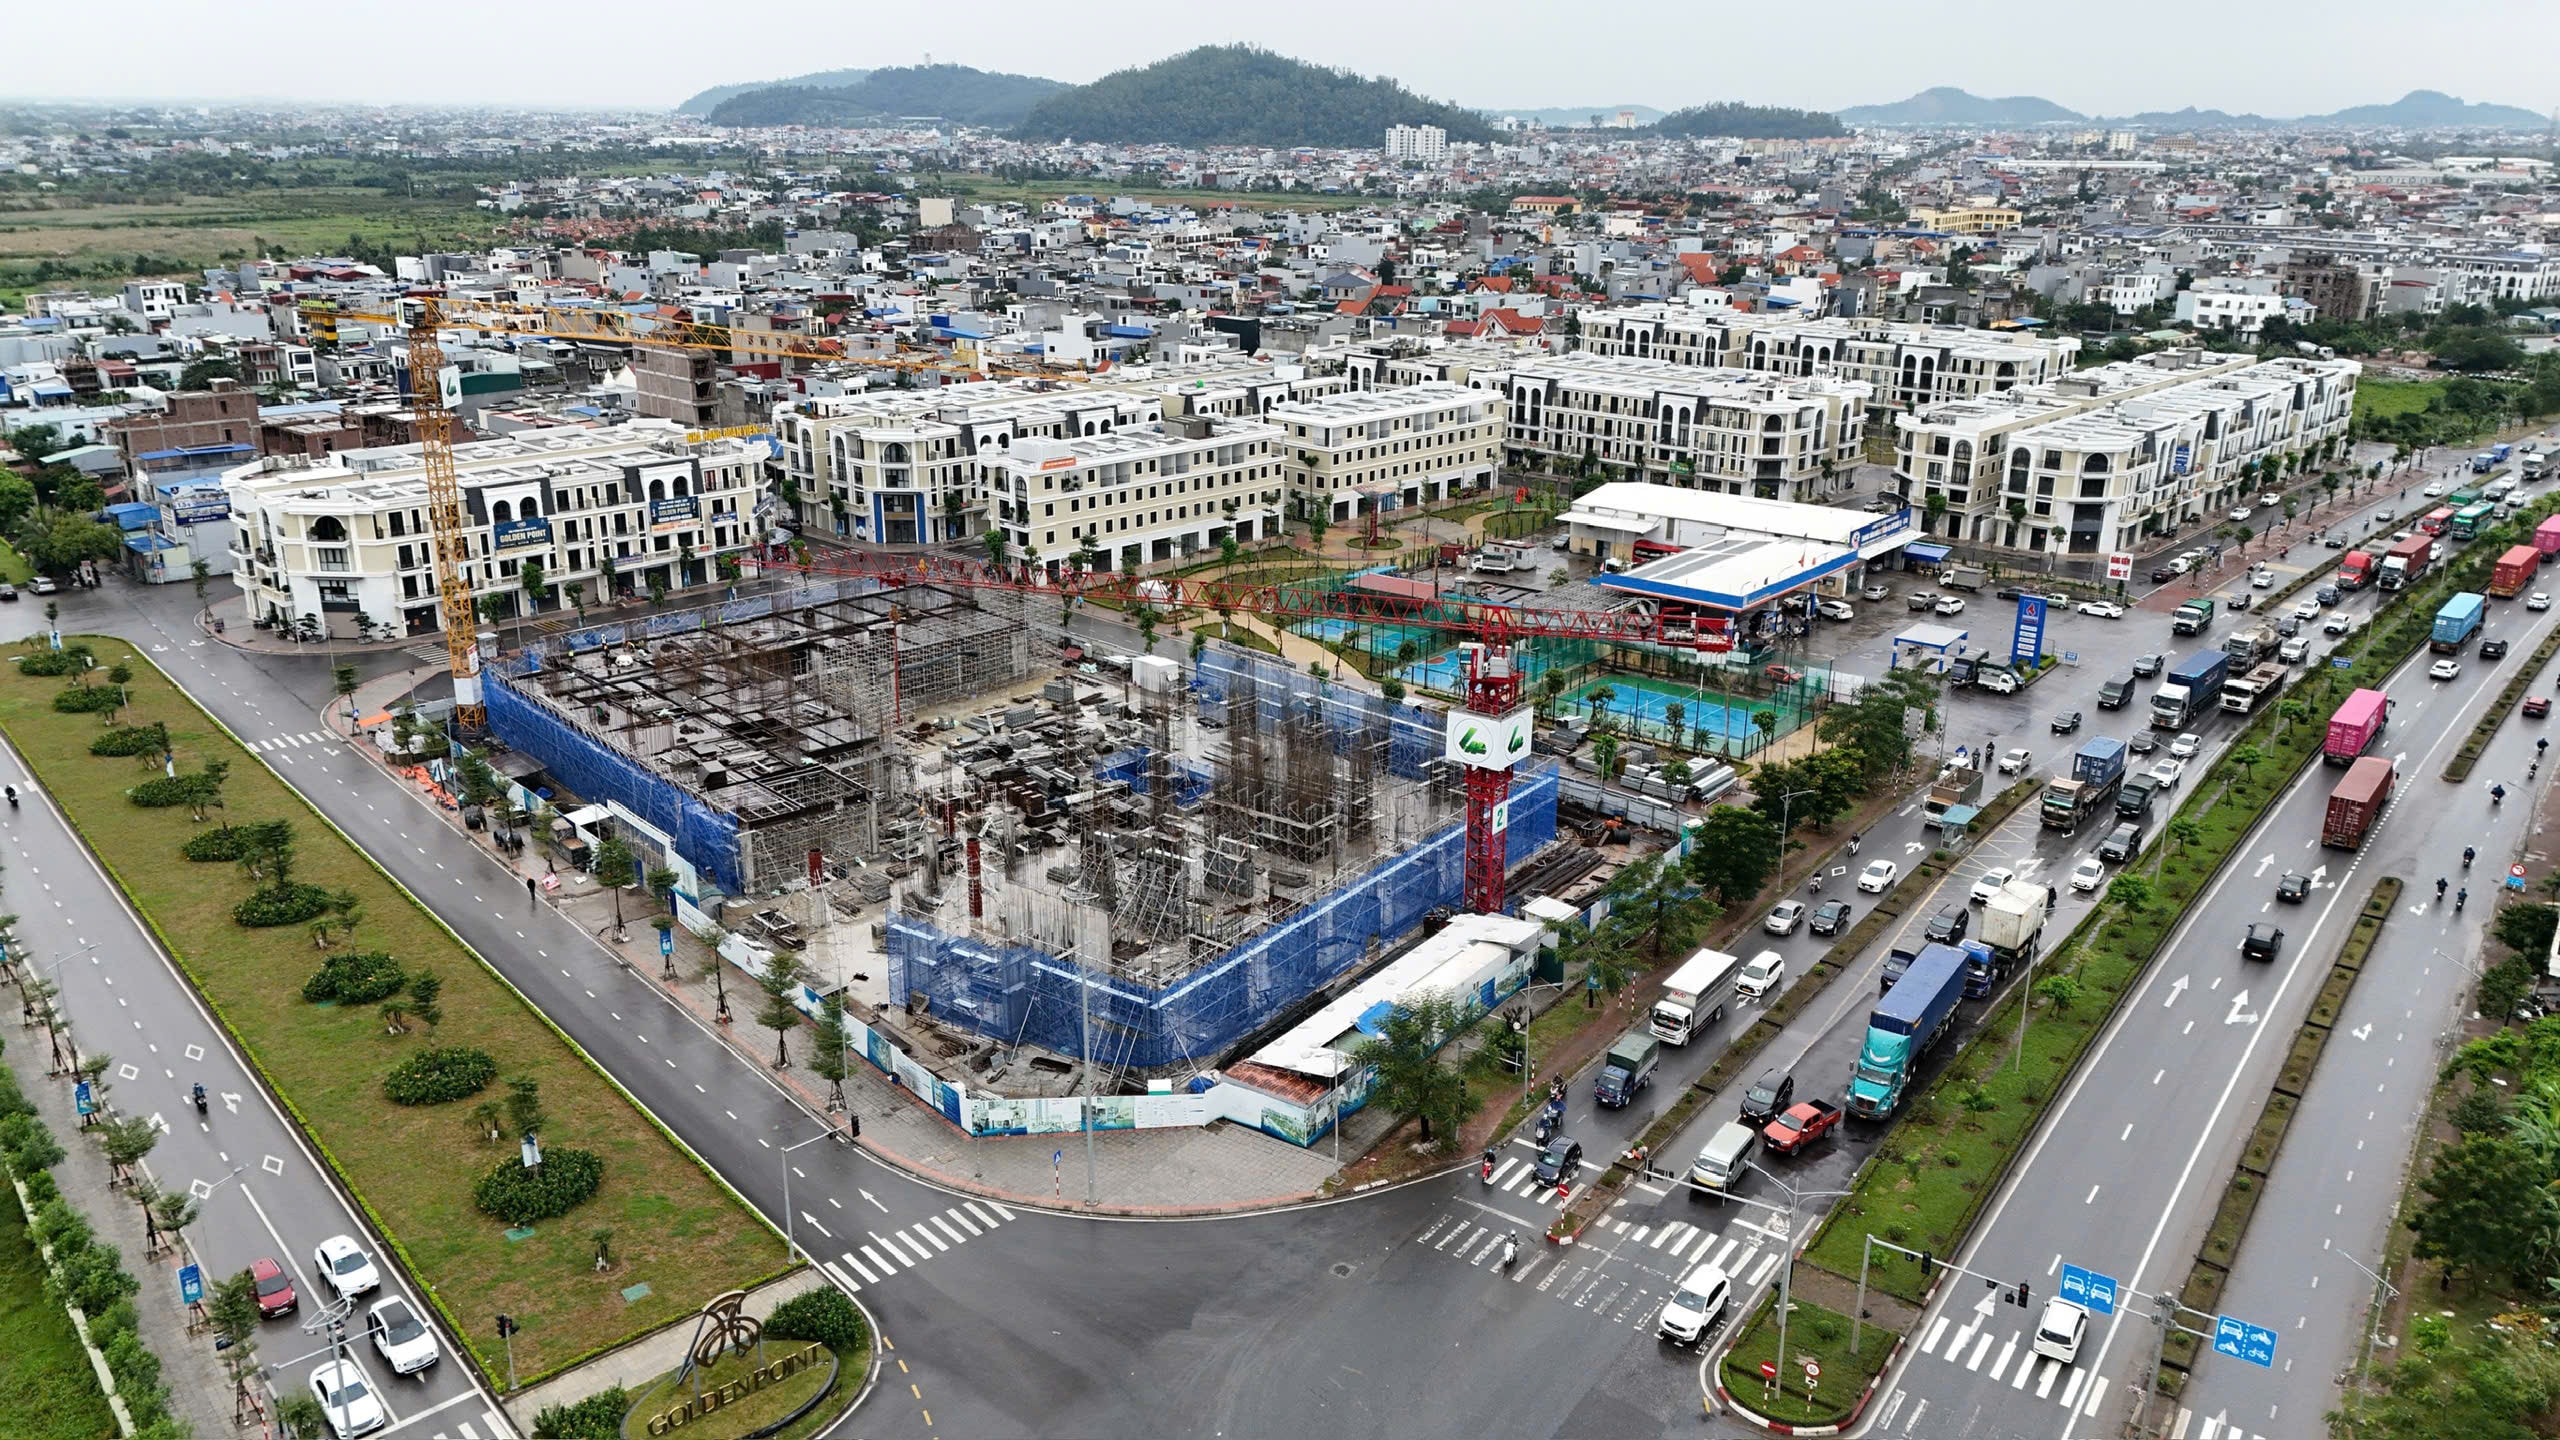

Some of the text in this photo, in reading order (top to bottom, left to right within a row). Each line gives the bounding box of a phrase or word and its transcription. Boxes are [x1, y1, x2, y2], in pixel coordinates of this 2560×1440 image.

[500, 532, 526, 543] GOLDEN
[527, 529, 546, 538] POINT
[1496, 807, 1503, 827] 2
[646, 1341, 823, 1437] GOLDEN POINT
